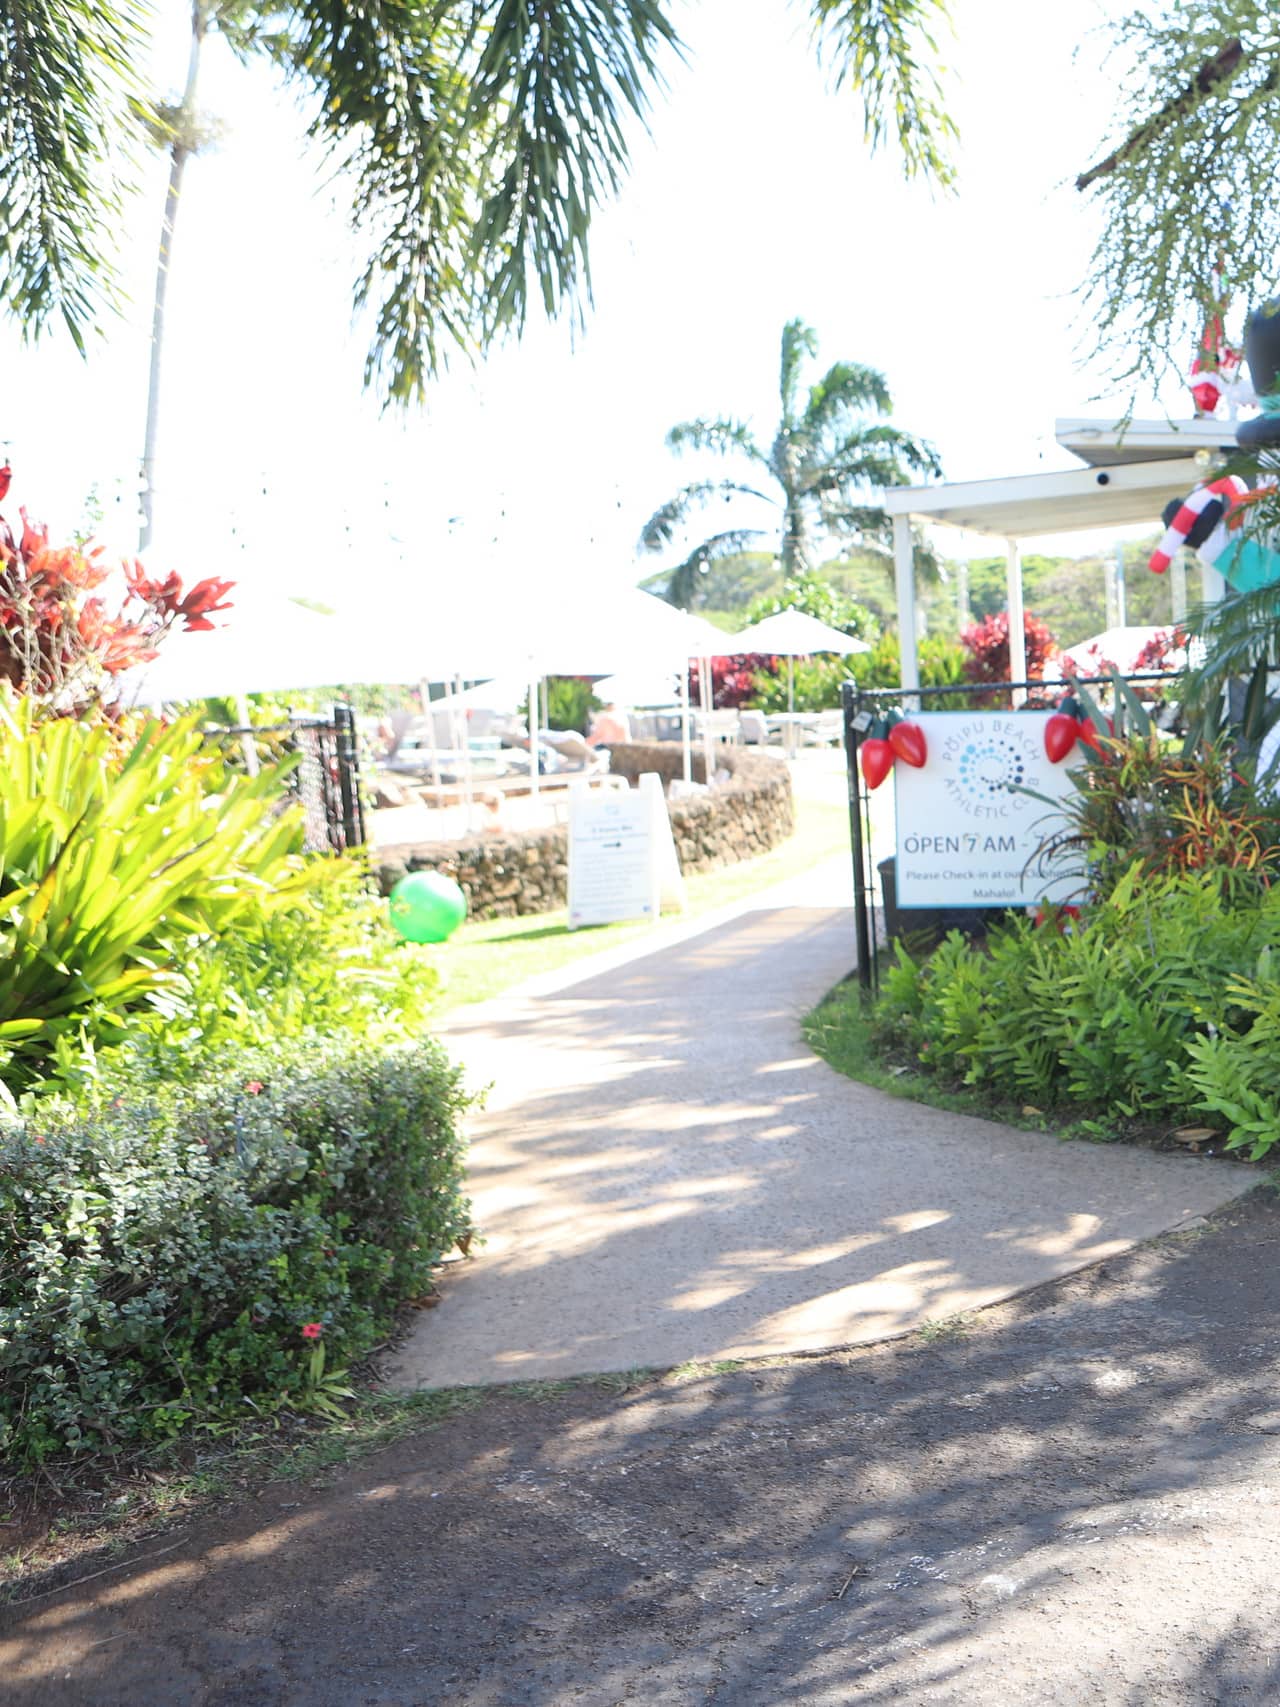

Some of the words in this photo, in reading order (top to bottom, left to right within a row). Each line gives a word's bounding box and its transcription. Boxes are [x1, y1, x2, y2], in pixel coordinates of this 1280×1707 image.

[993, 719, 1041, 761] BEACH
[943, 777, 1009, 819] ATHLETIC
[904, 836, 960, 854] OPEN
[967, 837, 977, 853] 7
[983, 836, 1016, 853] AM
[906, 870, 940, 880] Please
[942, 869, 989, 880] Check-in
[991, 869, 1002, 879] at
